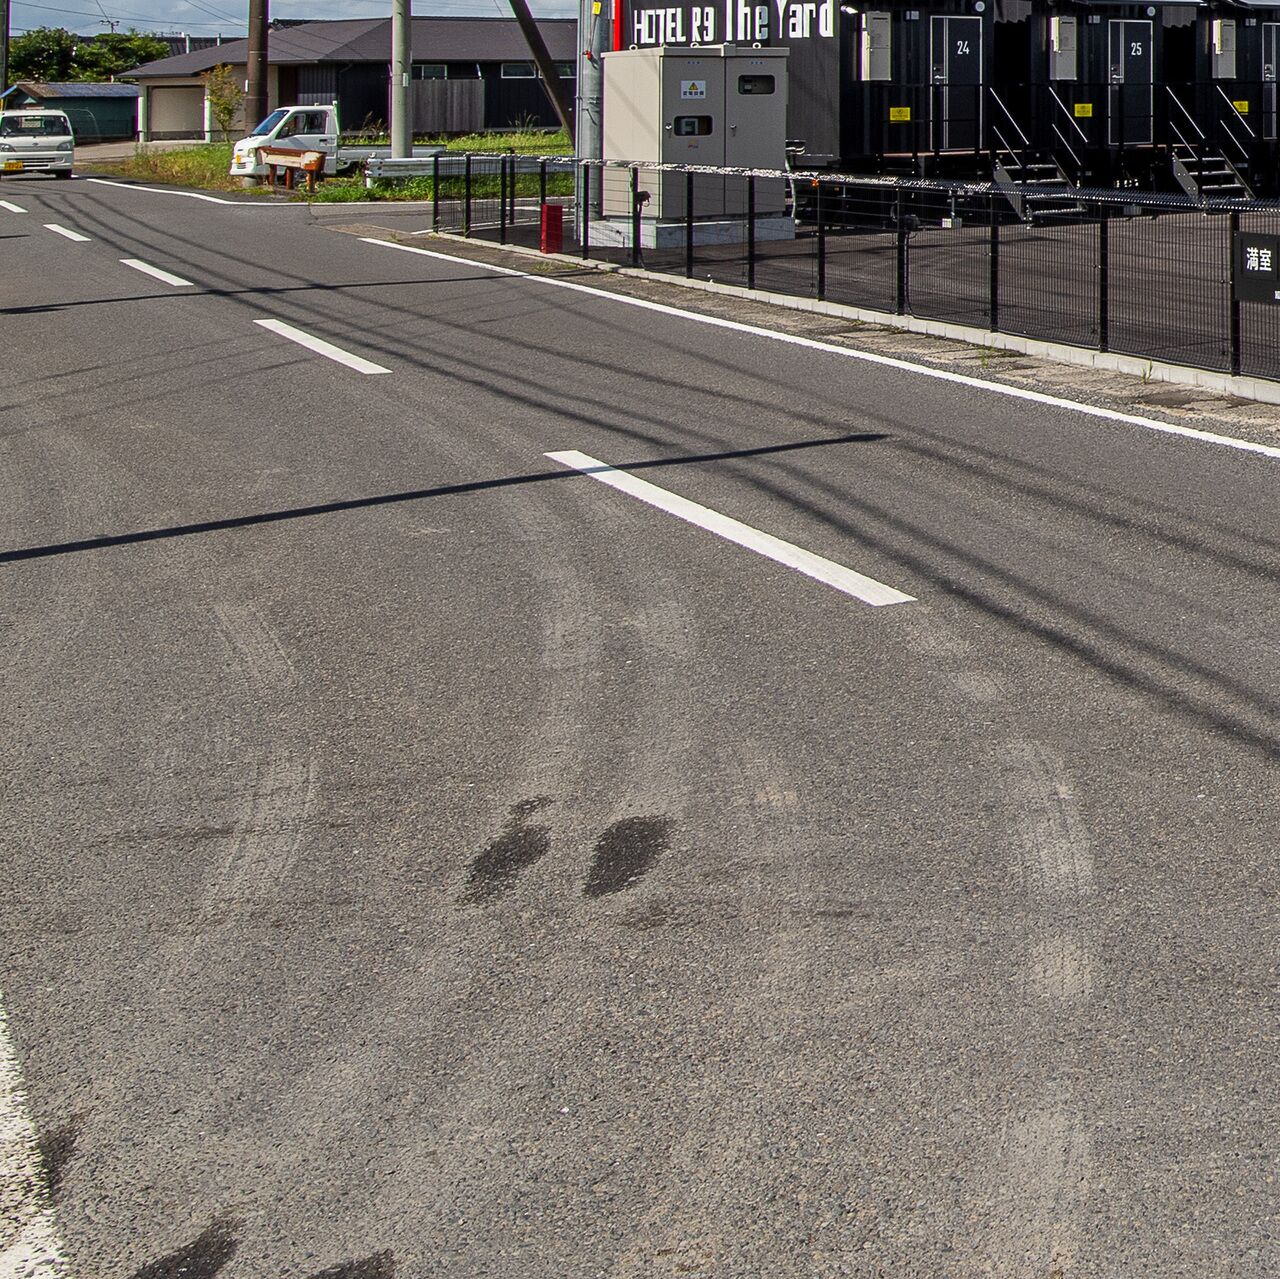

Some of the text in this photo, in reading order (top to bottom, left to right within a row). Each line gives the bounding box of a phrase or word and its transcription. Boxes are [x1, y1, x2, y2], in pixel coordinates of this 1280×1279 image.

[634, 7, 686, 44] HOTEL
[691, 6, 715, 42] R9
[957, 41, 970, 55] 24
[1130, 42, 1142, 56] 25
[1247, 247, 1272, 271] 満室
